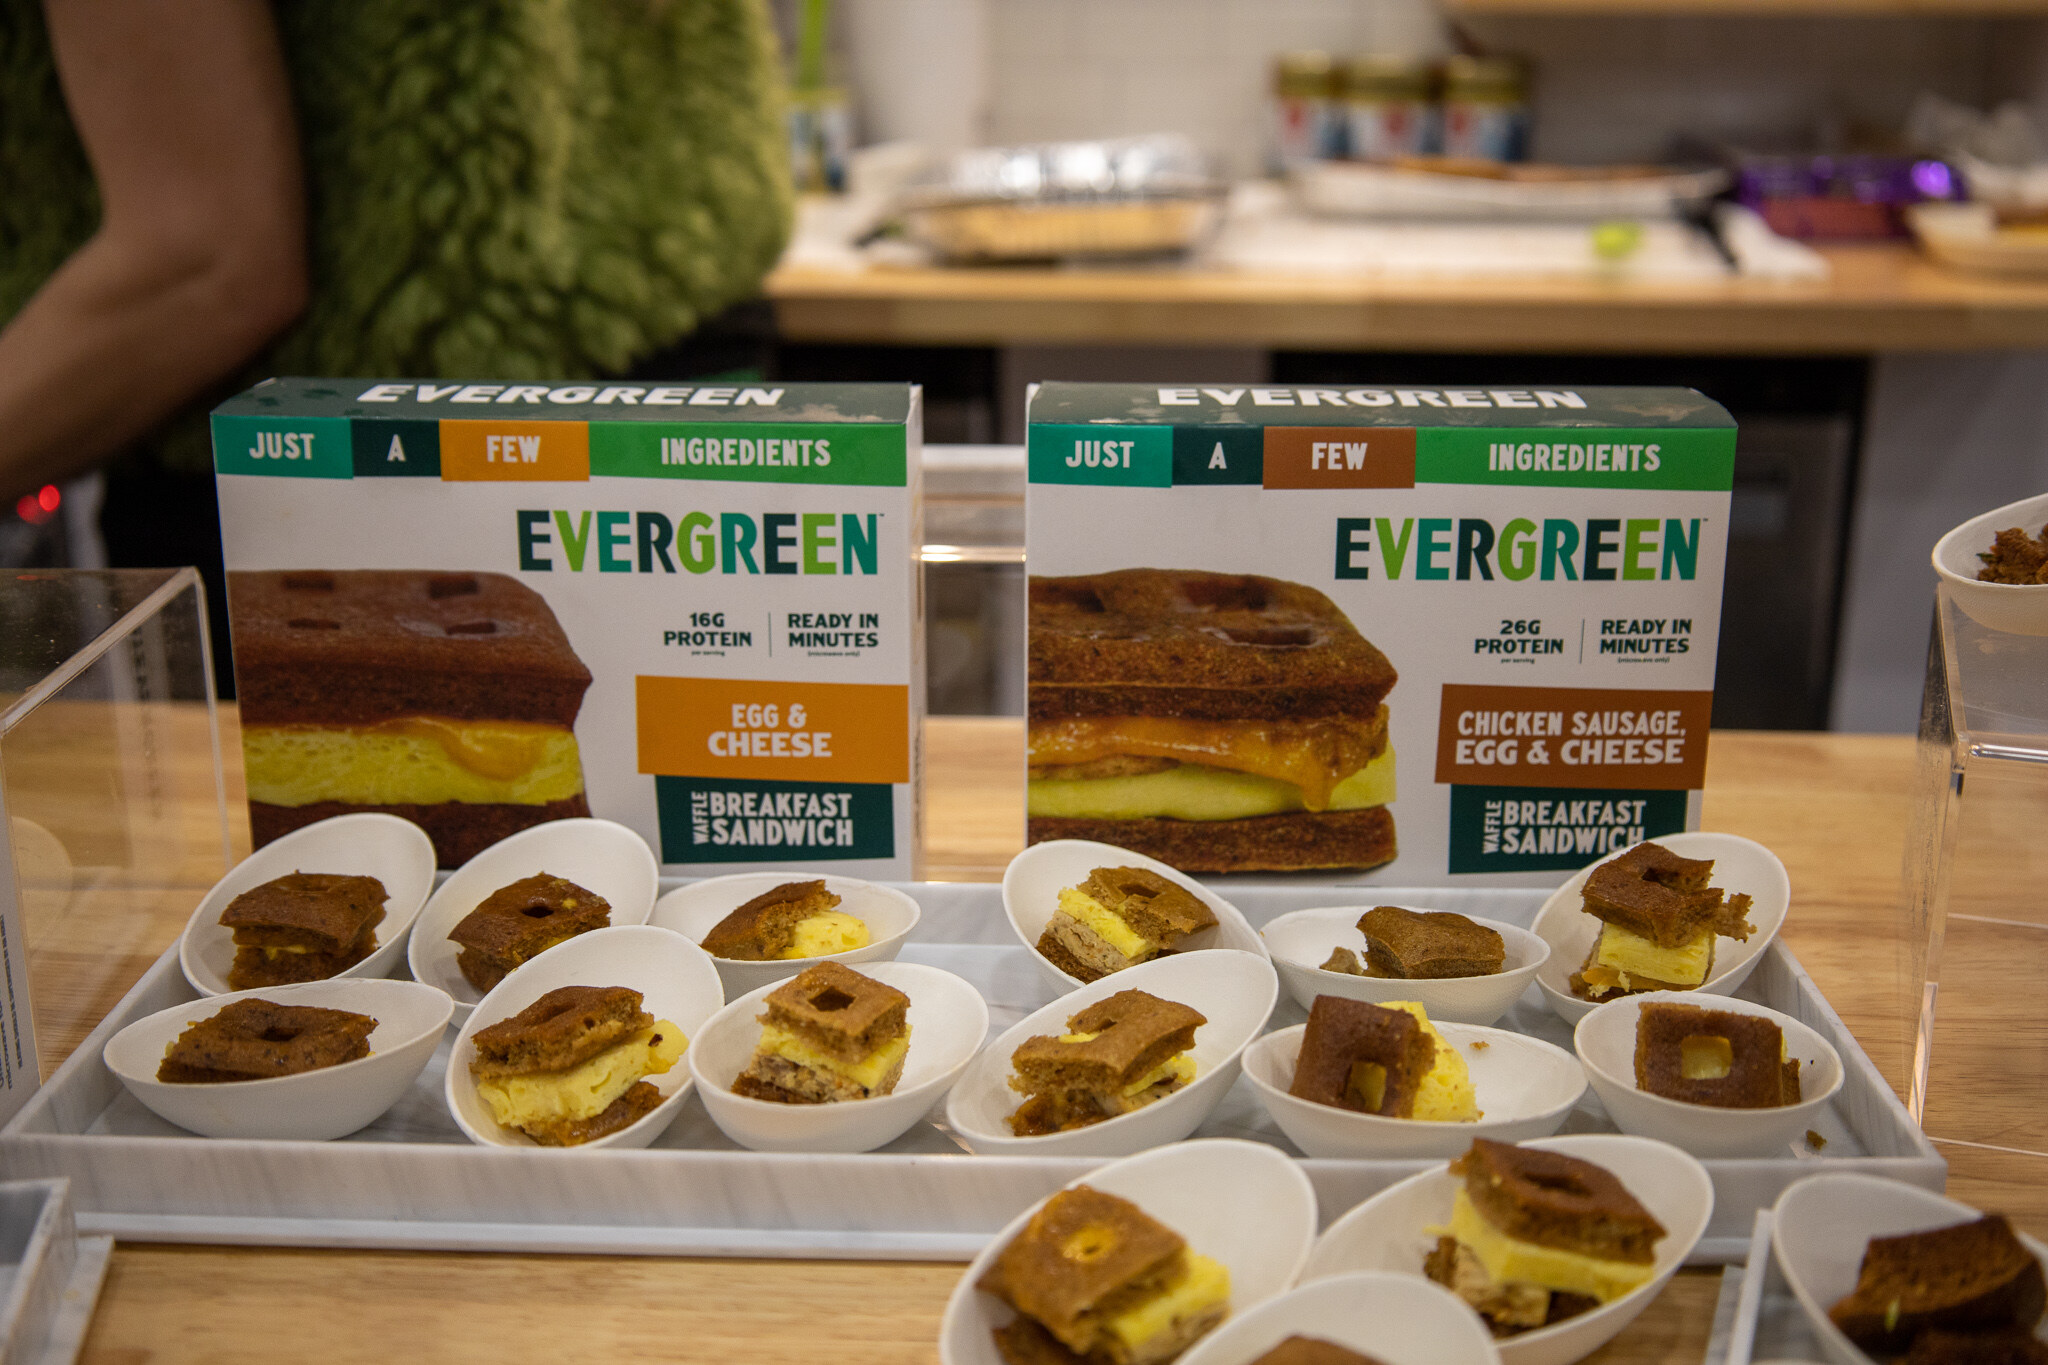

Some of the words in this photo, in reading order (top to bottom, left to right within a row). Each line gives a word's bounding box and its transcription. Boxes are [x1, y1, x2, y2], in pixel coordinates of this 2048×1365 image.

[357, 384, 786, 405] EVERGREEN
[1157, 388, 1588, 408] EVERGREEN
[249, 432, 314, 459] JUST
[387, 435, 405, 461] A
[487, 436, 541, 462] FEW
[661, 438, 830, 466] INGREDIENTS
[1066, 441, 1134, 467] JUST
[1208, 442, 1227, 469] A
[1312, 443, 1367, 470] FEW
[1489, 443, 1660, 471] INGREDIENTS
[516, 510, 878, 575] EVERGREEN
[1335, 518, 1700, 581] EVERGREEN
[690, 613, 724, 627] 16G
[788, 614, 852, 628] READY
[860, 614, 878, 628] IN
[1500, 620, 1540, 635] 26G
[1602, 620, 1666, 634] READY
[1673, 620, 1691, 634] IN
[664, 631, 751, 646] PROTEIN
[789, 633, 878, 647] MINUTES
[1475, 639, 1563, 653] PROTEIN
[1600, 638, 1689, 653] MINUTES
[732, 704, 778, 728] EGG
[788, 704, 806, 728] &
[1458, 711, 1562, 735] CHICKEN
[1571, 711, 1686, 738] SAUSAGE,
[708, 732, 832, 757] CHEESE
[1456, 740, 1517, 765] EGG
[1527, 740, 1549, 764] &
[1560, 738, 1685, 765] CHEESE
[710, 792, 852, 819] BREAKFAST
[1504, 801, 1646, 825] BREAKFAST
[691, 792, 708, 844] WAFFLE
[1483, 801, 1501, 853] WAFFLE
[712, 818, 853, 846] SANDWICH
